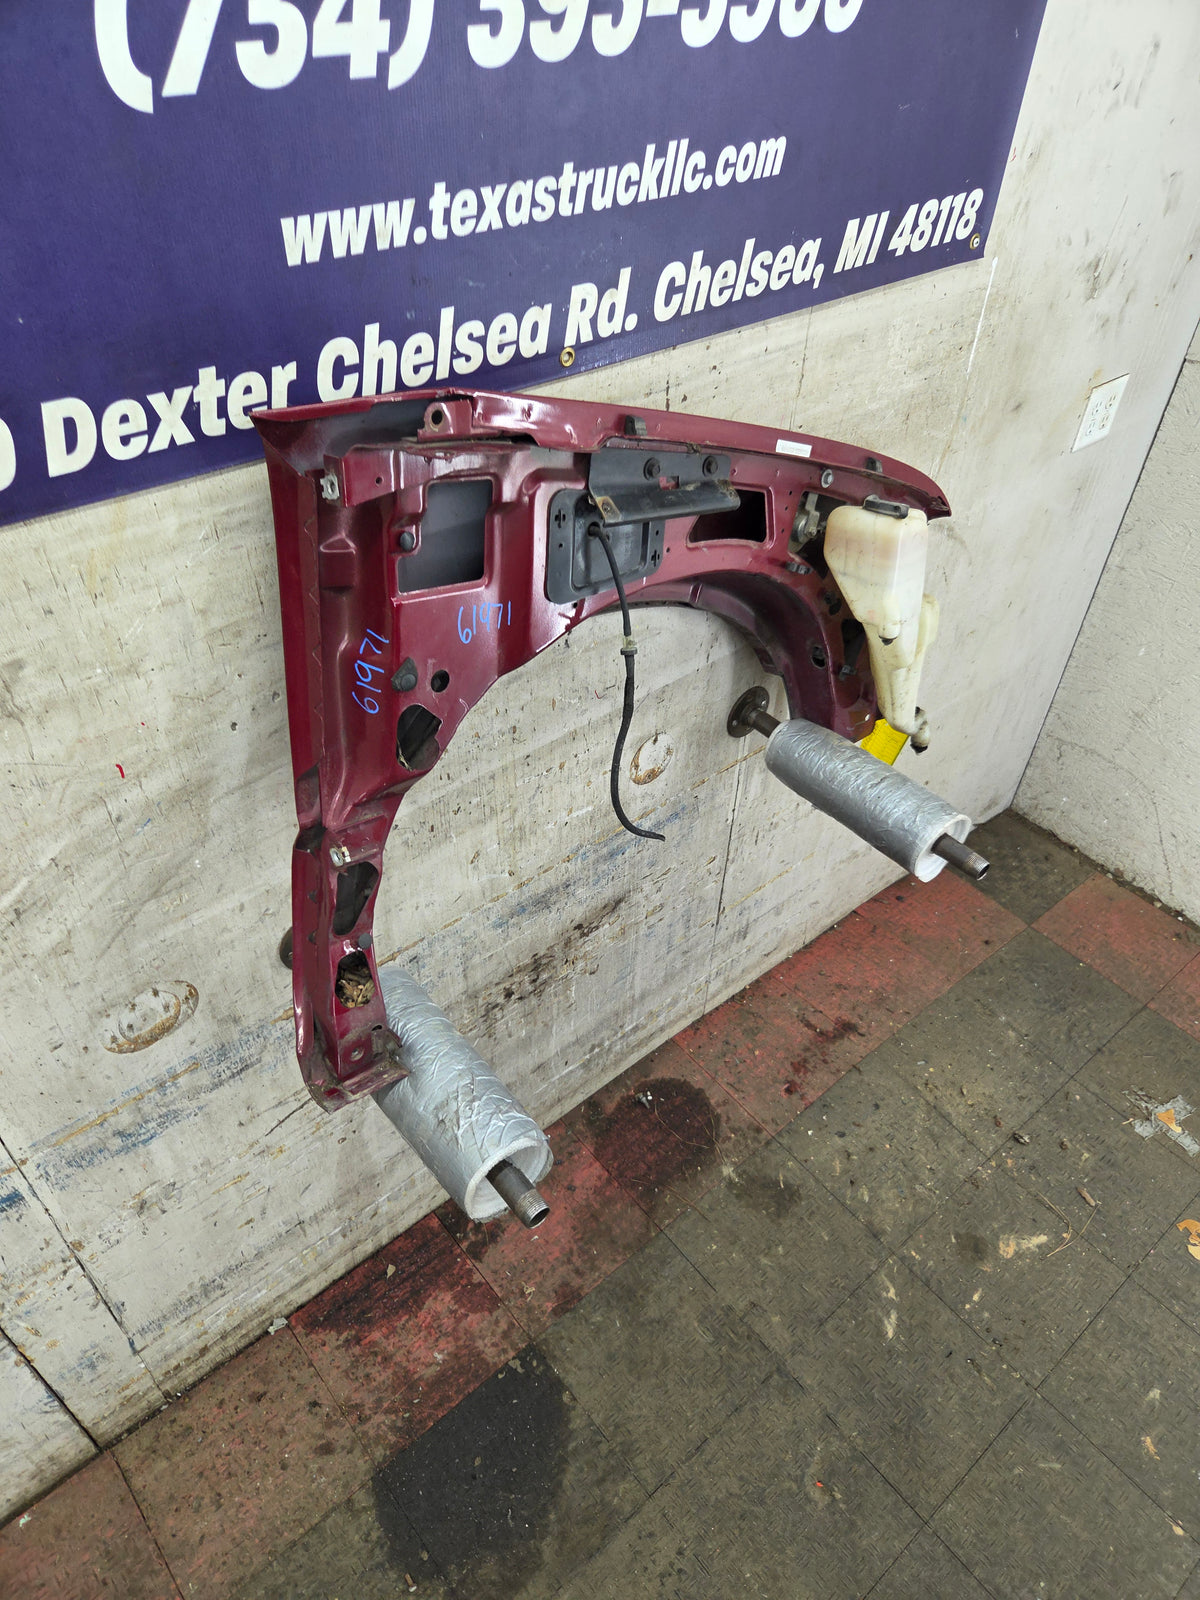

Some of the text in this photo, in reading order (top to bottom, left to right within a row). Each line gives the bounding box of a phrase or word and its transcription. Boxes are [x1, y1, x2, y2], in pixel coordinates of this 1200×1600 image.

[280, 135, 787, 267] www.texastruckllc.com
[40, 360, 297, 478] Dexter
[316, 305, 553, 403] Chelsea
[564, 268, 638, 348] Rd.
[653, 238, 825, 322] Chelsea,
[833, 211, 890, 274] MI
[887, 188, 984, 256] 48118
[352, 628, 389, 714] 61971
[457, 600, 512, 644] 61971
